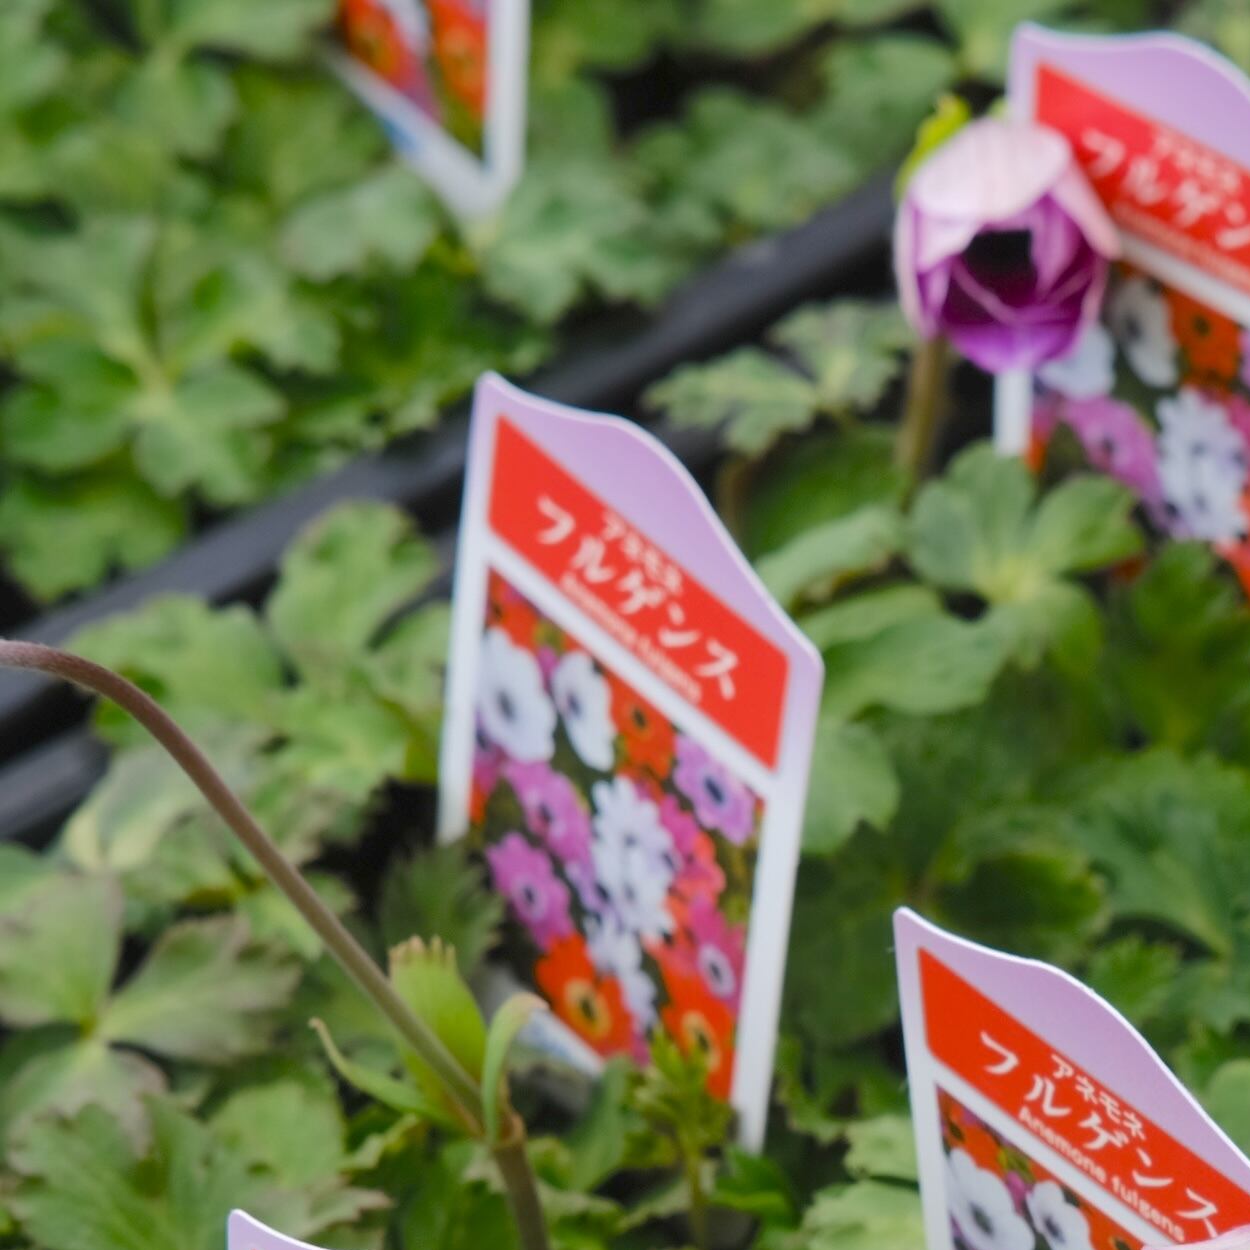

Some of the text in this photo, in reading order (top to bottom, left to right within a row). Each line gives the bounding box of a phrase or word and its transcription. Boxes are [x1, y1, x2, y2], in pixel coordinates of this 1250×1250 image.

[537, 495, 739, 701] フルゲンス
[980, 1031, 1218, 1239] フルゲンス
[1018, 1106, 1185, 1242] Anemone fulgens
[1051, 1054, 1146, 1140] アネモネ
